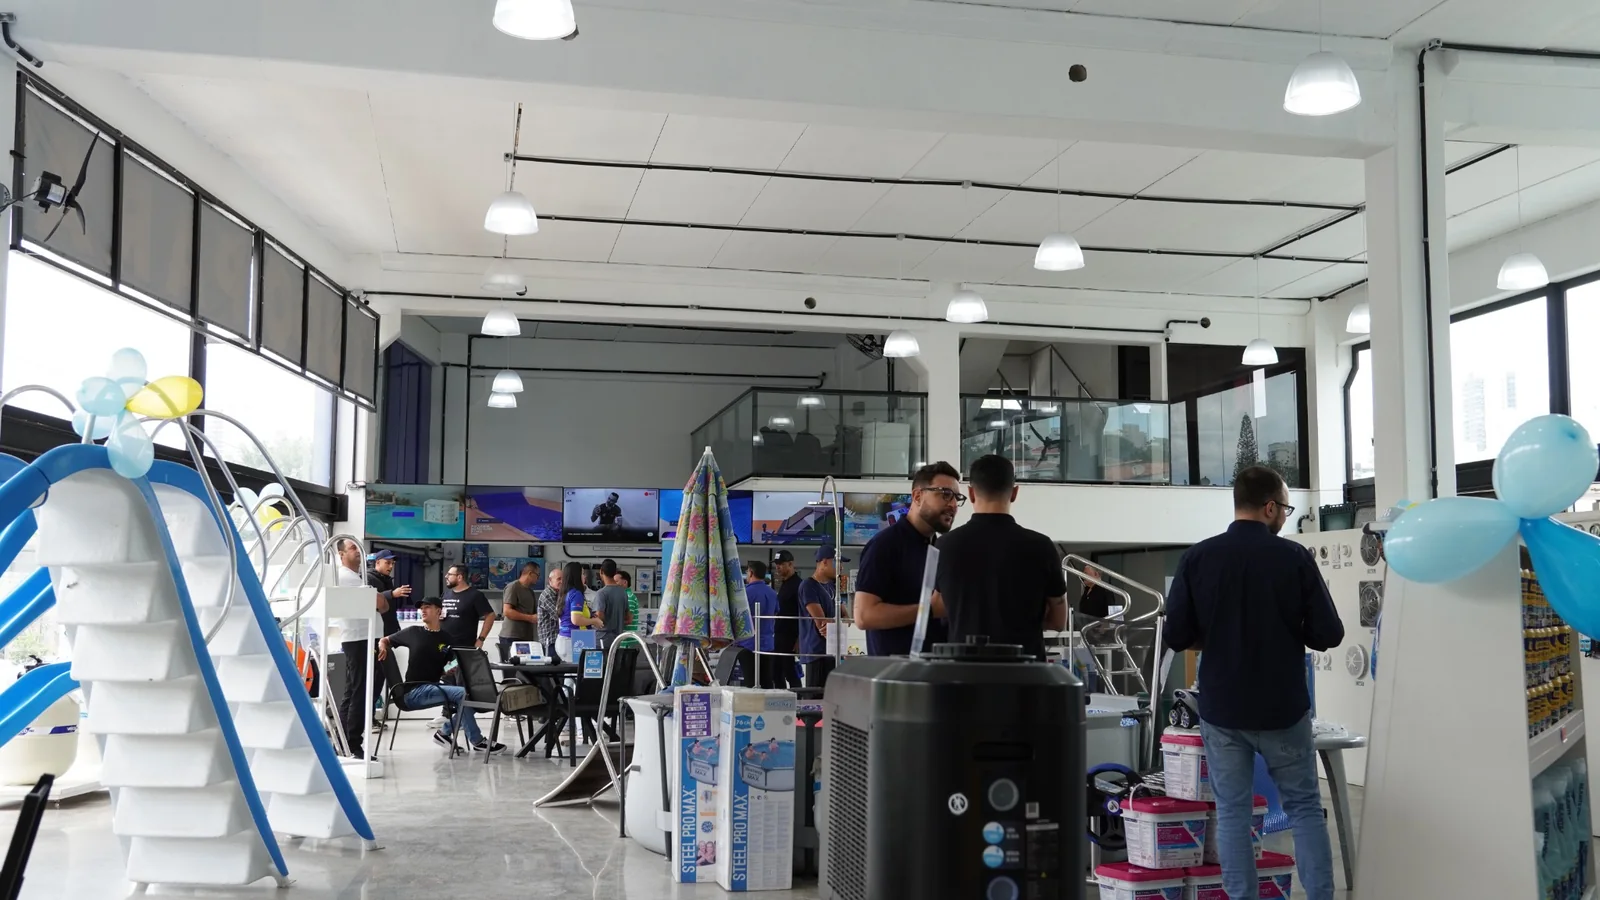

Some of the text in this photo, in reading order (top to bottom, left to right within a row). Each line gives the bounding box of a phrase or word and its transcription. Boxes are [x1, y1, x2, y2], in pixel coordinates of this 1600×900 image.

[682, 789, 696, 873] STEEL PRO MAX
[733, 794, 748, 881] STEEL PRO MAX
